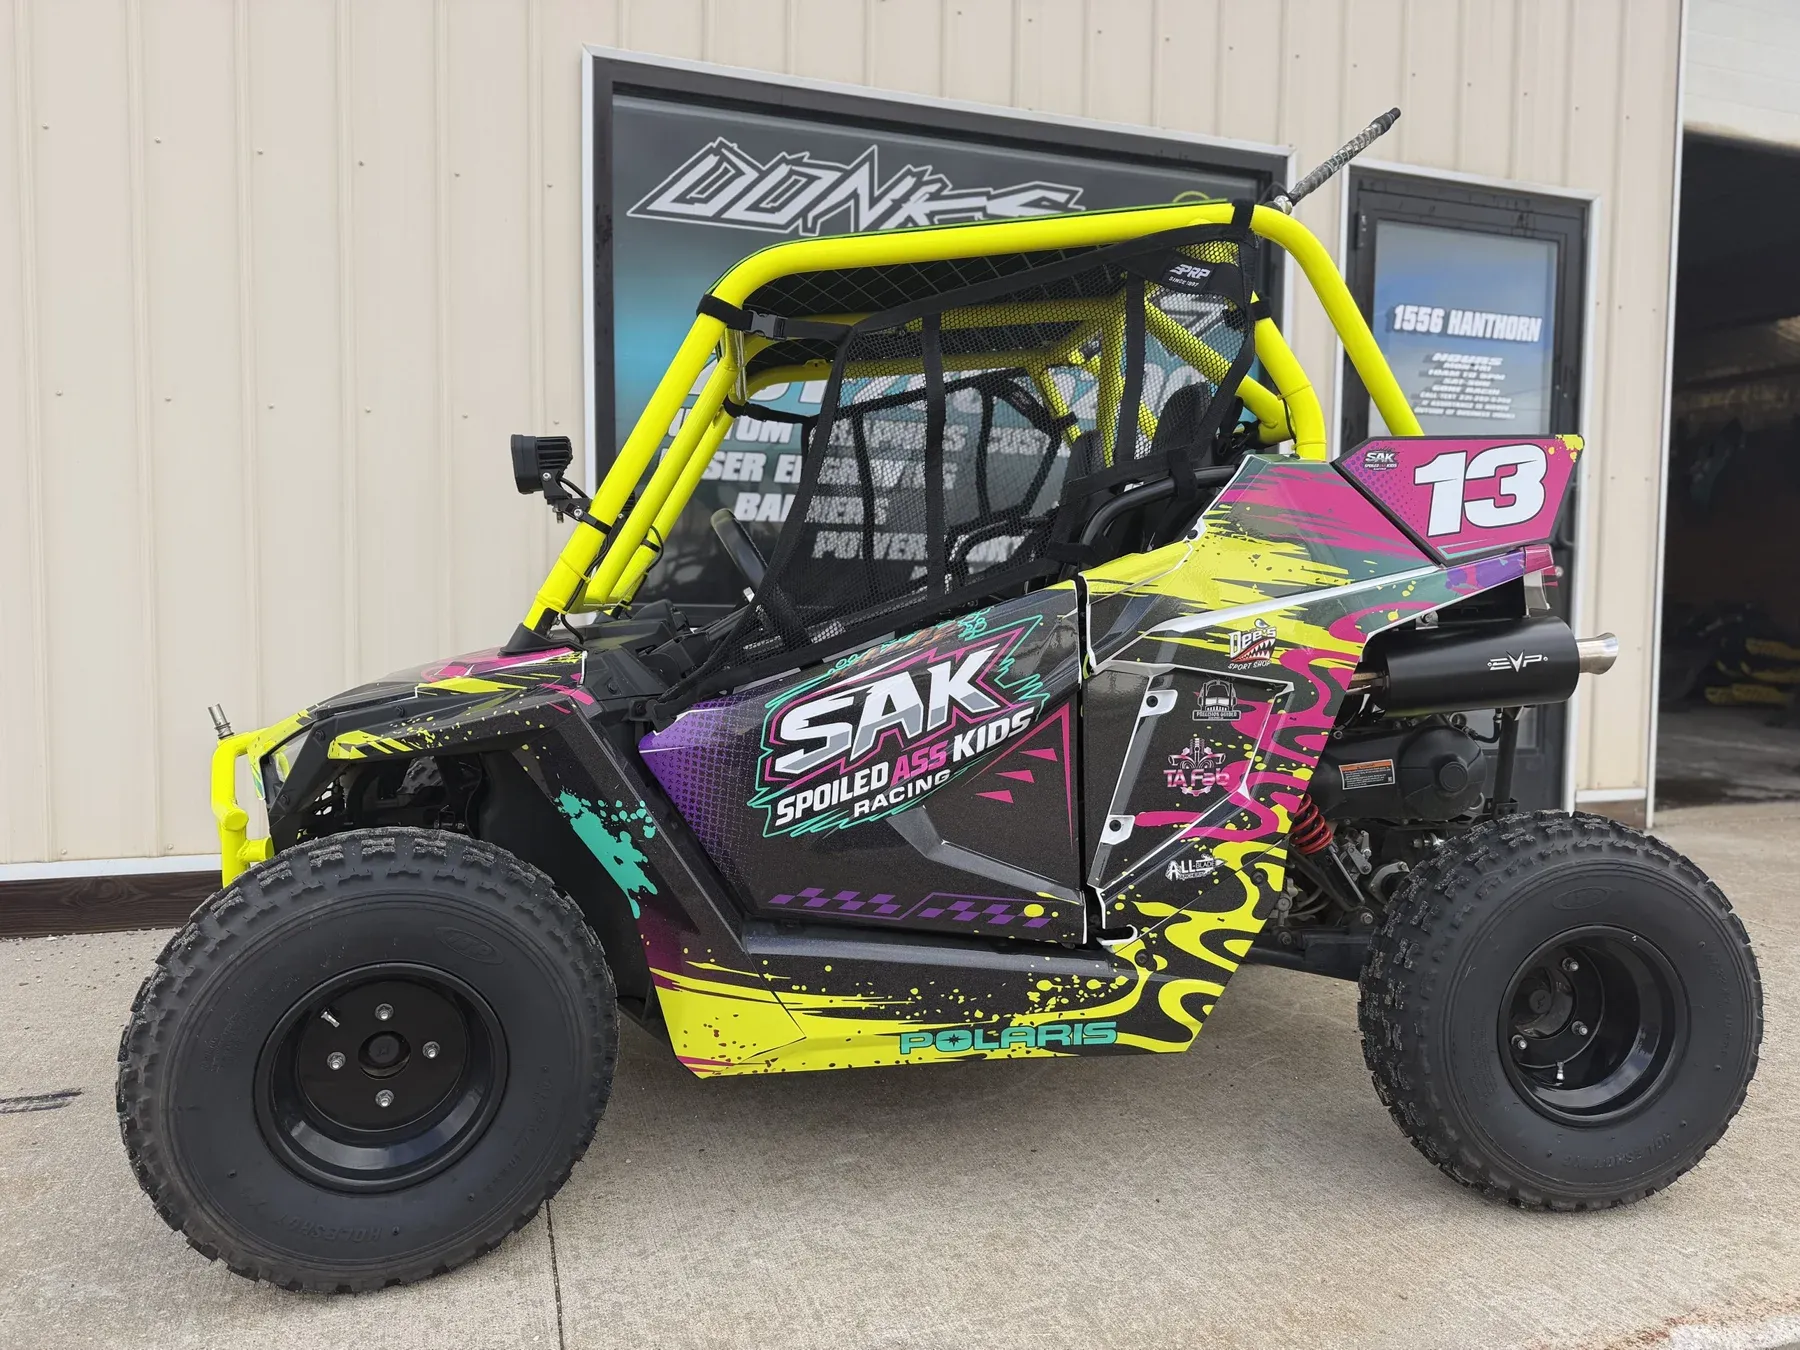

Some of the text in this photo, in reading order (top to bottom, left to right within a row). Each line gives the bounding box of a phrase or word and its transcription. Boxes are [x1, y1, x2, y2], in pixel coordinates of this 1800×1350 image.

[1393, 304, 1543, 343] 1556 HANTHORN
[1365, 451, 1396, 463] SAK
[1413, 443, 1547, 537] 13
[1227, 662, 1253, 671] SPORT
[774, 643, 1000, 775] SAK
[775, 705, 1035, 827] SPOILED ASS KIDS
[1163, 769, 1188, 788] TA
[853, 768, 951, 818] RACING
[900, 1021, 1117, 1055] POLARIS
